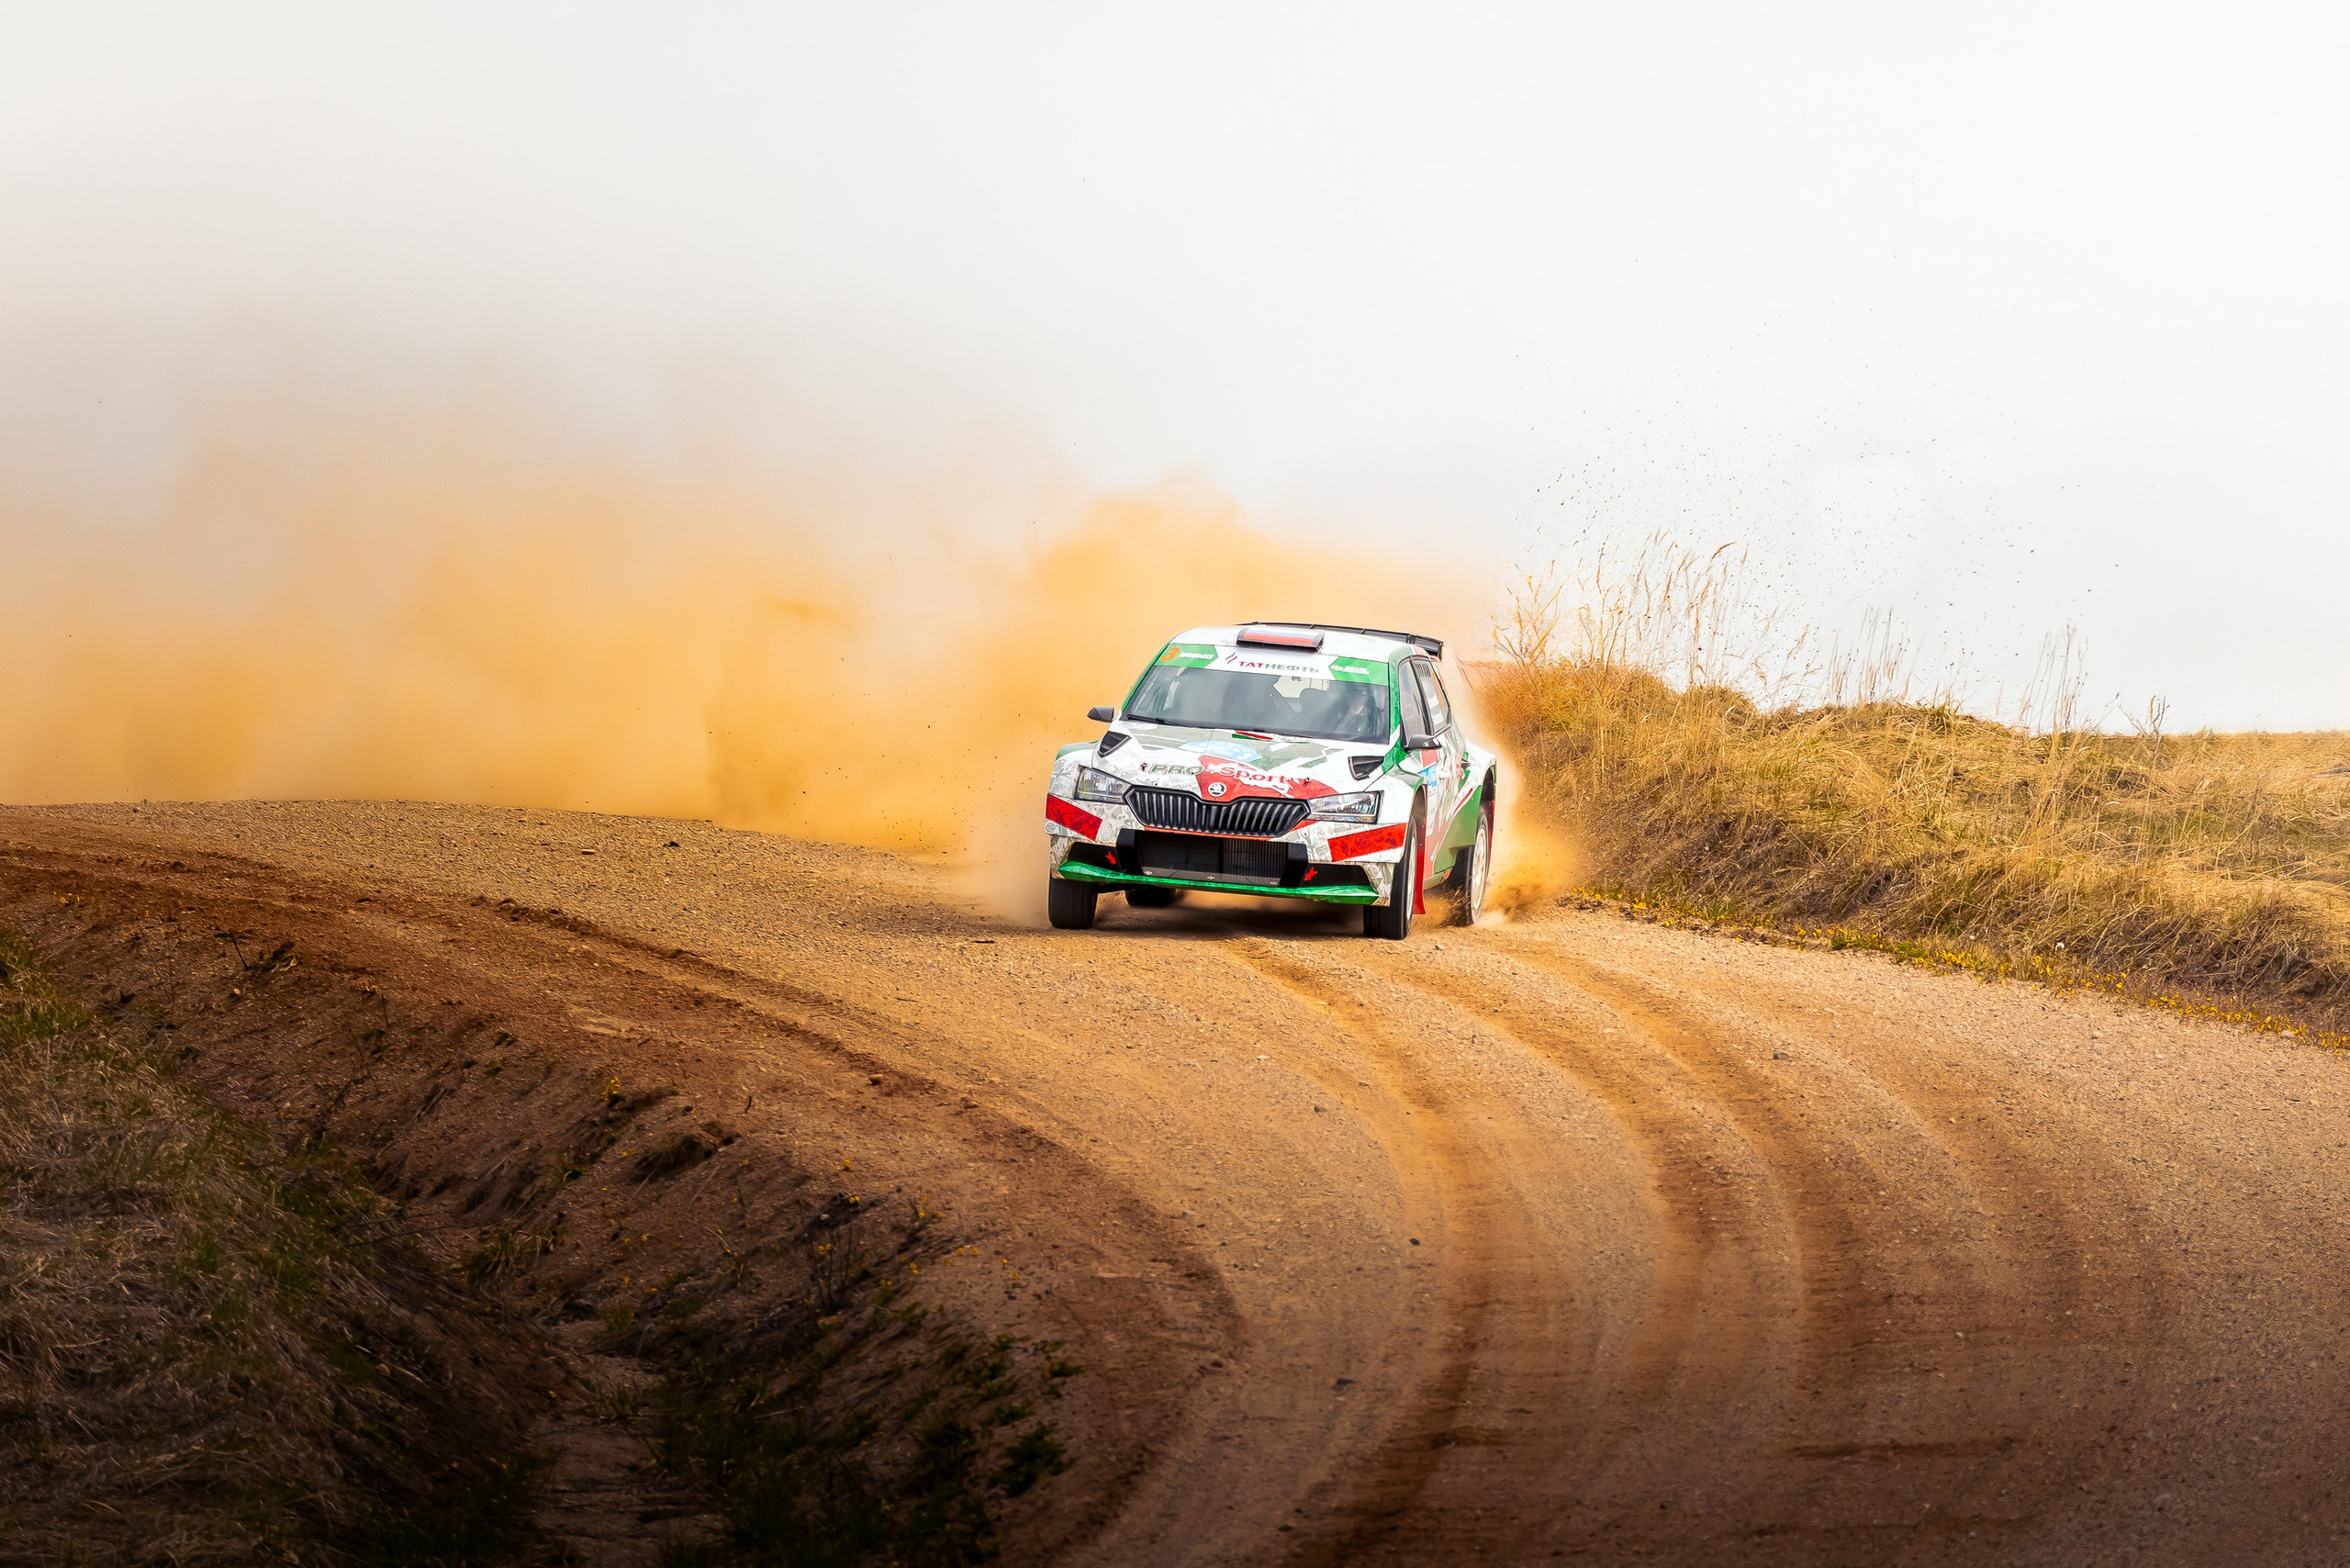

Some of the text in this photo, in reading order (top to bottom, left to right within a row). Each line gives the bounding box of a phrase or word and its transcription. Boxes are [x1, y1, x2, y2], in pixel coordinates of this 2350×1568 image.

[1160, 647, 1181, 661] 3
[1239, 661, 1319, 673] ТАТНЕФТЬ
[1148, 764, 1204, 775] PRO
